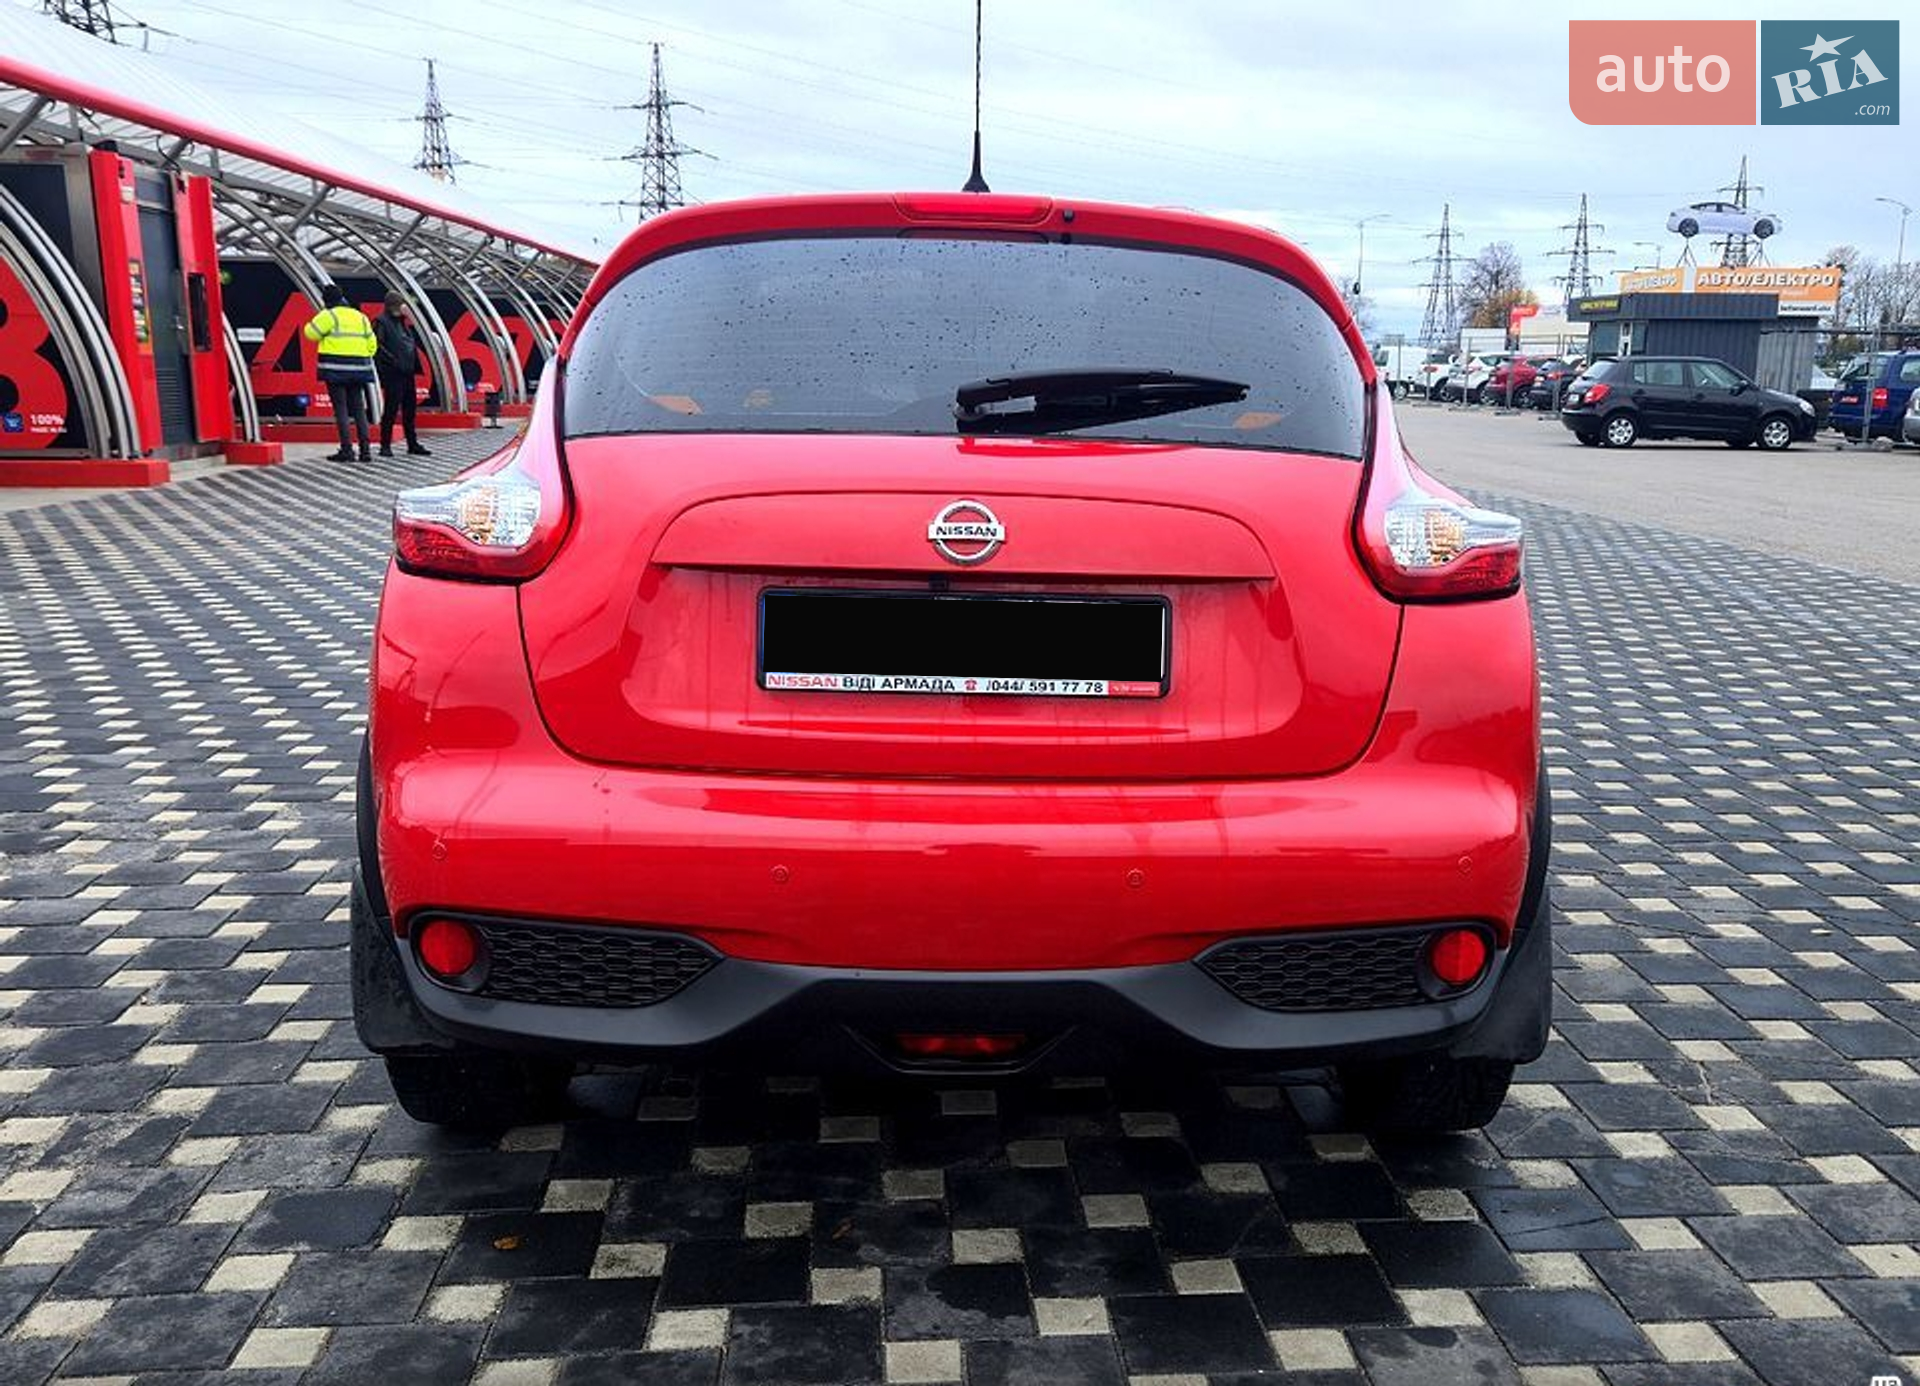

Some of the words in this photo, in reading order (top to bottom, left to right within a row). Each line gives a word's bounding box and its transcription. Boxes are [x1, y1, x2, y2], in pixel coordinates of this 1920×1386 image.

[1698, 272, 1834, 286] АВТО/ЕЛЕКТРО
[30, 414, 65, 425] 100%
[936, 526, 998, 537] NISSAN
[767, 675, 838, 688] NISSAN
[881, 677, 956, 692] АРМАДА
[1029, 681, 1055, 693] 591
[1062, 681, 1078, 693] 77
[1085, 682, 1104, 693] 78
